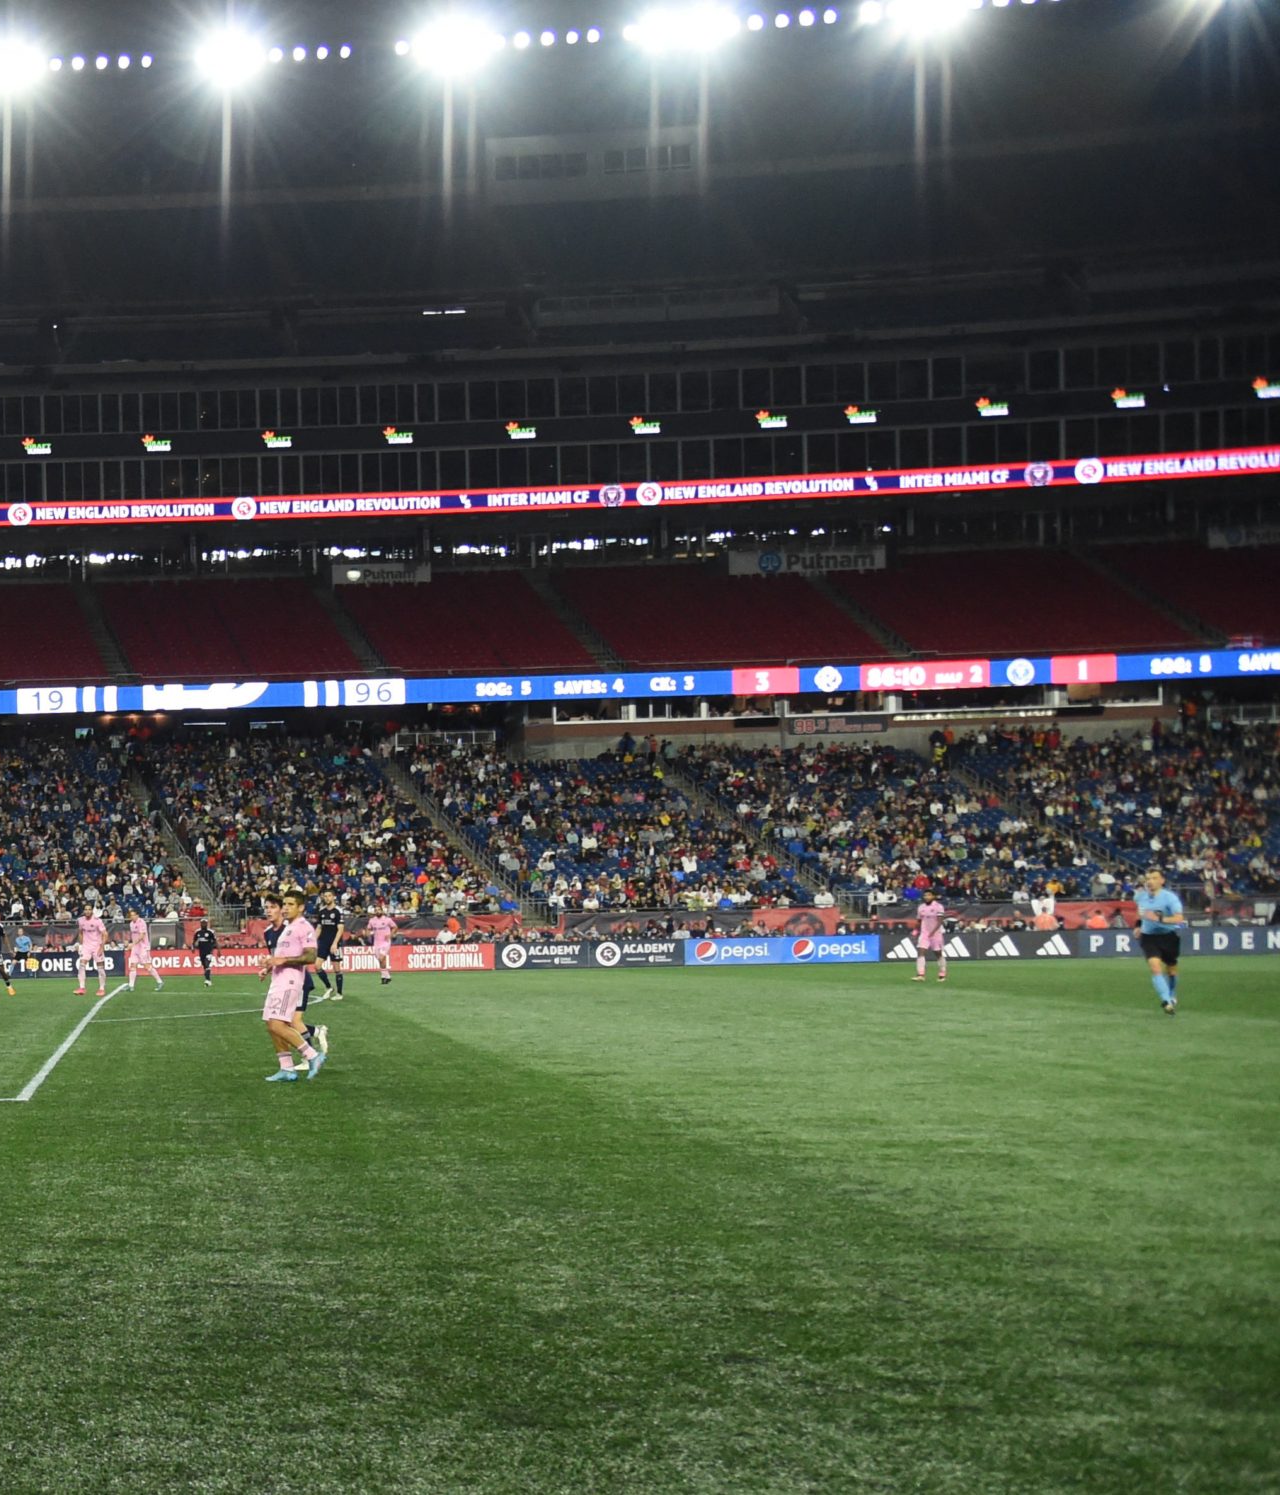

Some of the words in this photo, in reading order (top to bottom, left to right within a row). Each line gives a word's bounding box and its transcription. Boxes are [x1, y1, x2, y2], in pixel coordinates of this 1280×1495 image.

[1106, 461, 1142, 477] NEW
[1142, 456, 1216, 475] ENGLAND
[899, 475, 943, 489] INTER
[944, 472, 990, 487] MIAMI
[991, 470, 1010, 484] CF
[664, 486, 696, 499] NEW
[698, 482, 762, 498] ENGLAND
[765, 478, 854, 496] REVOLUTION
[260, 501, 290, 514] NEW
[292, 499, 354, 513] ENGLAND
[357, 496, 440, 512] REVOLUTION
[487, 493, 528, 506] INTER
[529, 491, 571, 505] MIAMI
[573, 490, 590, 503] CF
[35, 507, 66, 520] NEW
[68, 505, 129, 519] ENGLAND
[131, 503, 214, 518] REVOLUTION
[787, 552, 876, 571] Putnam
[363, 568, 416, 580] Putnam
[970, 666, 983, 683] 2
[1078, 659, 1088, 681] 1
[475, 682, 512, 697] SOG:
[521, 681, 532, 695] 5
[553, 679, 608, 695] SAVES:
[612, 678, 624, 694] 4
[650, 677, 677, 692] CK:
[684, 676, 695, 691] 3
[755, 672, 770, 692] 3
[32, 690, 64, 711] 19
[355, 682, 392, 703] 96
[412, 945, 435, 954] NEW
[436, 943, 479, 953] ENGLAND
[528, 945, 581, 956] ACADEMY
[622, 943, 676, 954] ACADEMY
[721, 942, 769, 960] pepsi
[818, 940, 868, 958] pepsi
[41, 958, 73, 972] ONE
[183, 956, 192, 968] A
[193, 955, 244, 969] SASON
[351, 954, 391, 971] JOURNL
[408, 954, 442, 969] SOCCER
[443, 952, 484, 970] JOURNAL
